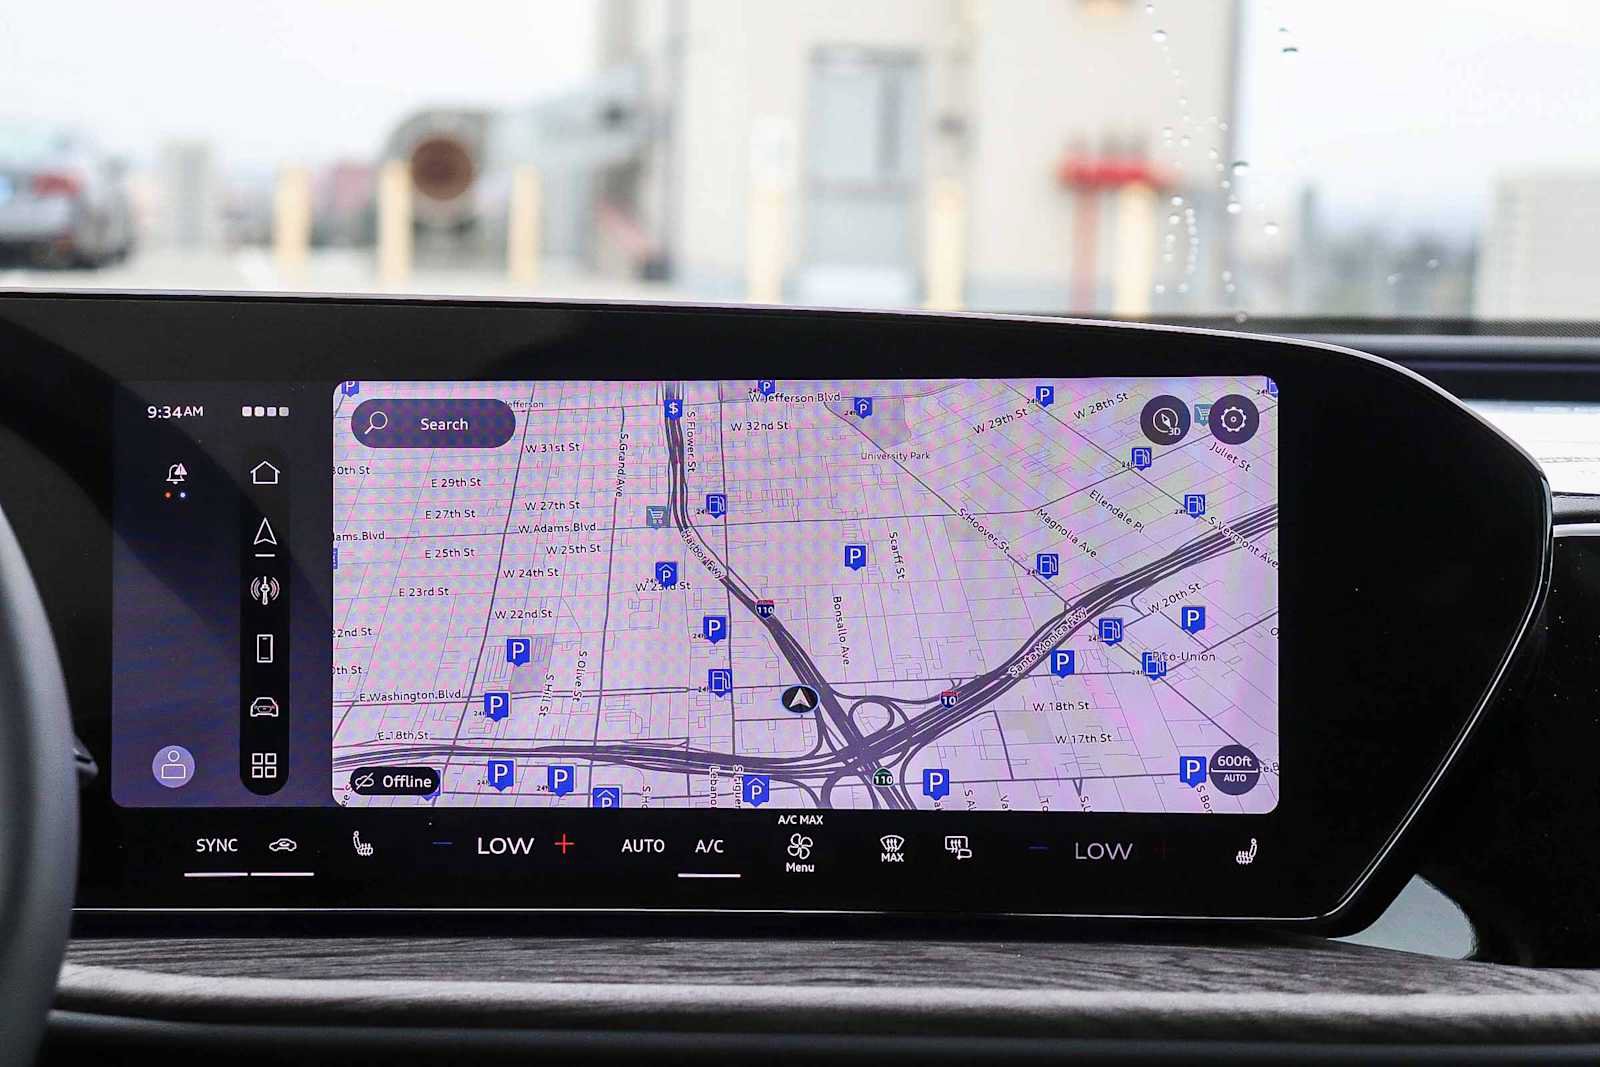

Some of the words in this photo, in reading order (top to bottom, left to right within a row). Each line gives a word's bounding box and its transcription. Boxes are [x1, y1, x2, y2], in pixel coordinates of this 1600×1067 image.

[763, 394, 814, 404] Jefferson
[817, 392, 840, 402] Blvd
[1089, 398, 1114, 415] 28th
[1116, 392, 1128, 403] St
[147, 406, 203, 418] 9:34AM
[421, 418, 468, 431] Search
[731, 423, 742, 431] W
[747, 422, 773, 430] 32nd
[777, 421, 788, 430] St
[973, 425, 985, 434] W
[989, 413, 1014, 429] 29th
[1016, 408, 1027, 418] St
[1168, 427, 1180, 435] 3D
[687, 421, 695, 457] Flower
[526, 445, 537, 453] W
[541, 444, 565, 452] 31st
[569, 443, 580, 452] St
[618, 443, 628, 476] Grand
[861, 452, 907, 461] University
[910, 452, 930, 460] Park
[1210, 443, 1237, 464] Juliet
[1239, 460, 1251, 472] St
[359, 466, 370, 474] St
[688, 461, 695, 472] St
[432, 479, 436, 487] E
[441, 479, 466, 487] 29th
[471, 478, 481, 487] St
[615, 479, 624, 497] Ave
[525, 502, 536, 510] W
[541, 502, 565, 510] 27th
[569, 500, 580, 510] St
[425, 511, 430, 519] E
[435, 510, 460, 518] 27th
[465, 509, 475, 518] St
[1089, 489, 1132, 523] Ellendale
[1134, 520, 1144, 533] Pl
[534, 524, 570, 532] Adams
[574, 523, 597, 532] Blvd
[362, 532, 385, 540] Blvd
[965, 515, 997, 542] Hoover
[998, 541, 1009, 553] St
[1037, 509, 1078, 544] Magnolia
[1079, 540, 1097, 558] Ave
[561, 545, 586, 554] 25th
[590, 544, 601, 552] St
[1217, 522, 1260, 555] Vermont
[1260, 551, 1278, 568] Ave
[425, 550, 430, 558] E
[435, 549, 460, 557] 25th
[464, 548, 475, 557] St
[681, 530, 707, 562] Harbor
[707, 560, 723, 579] Fwy
[889, 531, 903, 565] Scarff
[896, 567, 905, 579] St
[503, 570, 515, 578] W
[519, 569, 543, 577] 24th
[547, 568, 559, 577] St
[409, 588, 434, 596] 23rd
[438, 587, 448, 596] St
[636, 583, 646, 591] W
[680, 582, 691, 590] St
[1162, 589, 1187, 607] 20th
[1188, 583, 1201, 594] St
[495, 611, 506, 619] W
[510, 610, 537, 618] 22nd
[542, 609, 552, 618] St
[361, 628, 372, 636] St
[833, 596, 847, 643] Bonsallo
[840, 646, 849, 665] Ave
[1008, 653, 1038, 676] Santa
[1035, 623, 1068, 654] Monica
[1067, 608, 1087, 626] Fwy
[1152, 652, 1215, 661] Pico-Union
[351, 666, 362, 674] St
[575, 660, 586, 688] Olive
[370, 691, 434, 702] Washington
[439, 690, 461, 698] Blvd
[572, 691, 582, 702] St
[539, 705, 548, 716] St
[1033, 703, 1045, 711] W
[1050, 702, 1074, 711] 18th
[1078, 702, 1089, 710] St
[390, 731, 413, 739] 18th
[417, 731, 428, 739] St
[1055, 735, 1067, 743] W
[1071, 734, 1096, 743] 17th
[1100, 734, 1112, 742] St
[1217, 756, 1251, 767] 600ft
[383, 775, 432, 788] Offline
[1224, 774, 1246, 782] AUTO
[778, 815, 797, 824] A/C
[800, 815, 823, 824] MAX
[196, 839, 238, 852] SYNC
[478, 837, 534, 854] LOW
[621, 839, 665, 852] AUTO
[695, 840, 724, 853] A/C
[1076, 843, 1133, 860] LOW
[881, 853, 904, 862] MAX
[786, 862, 814, 872] Menu
